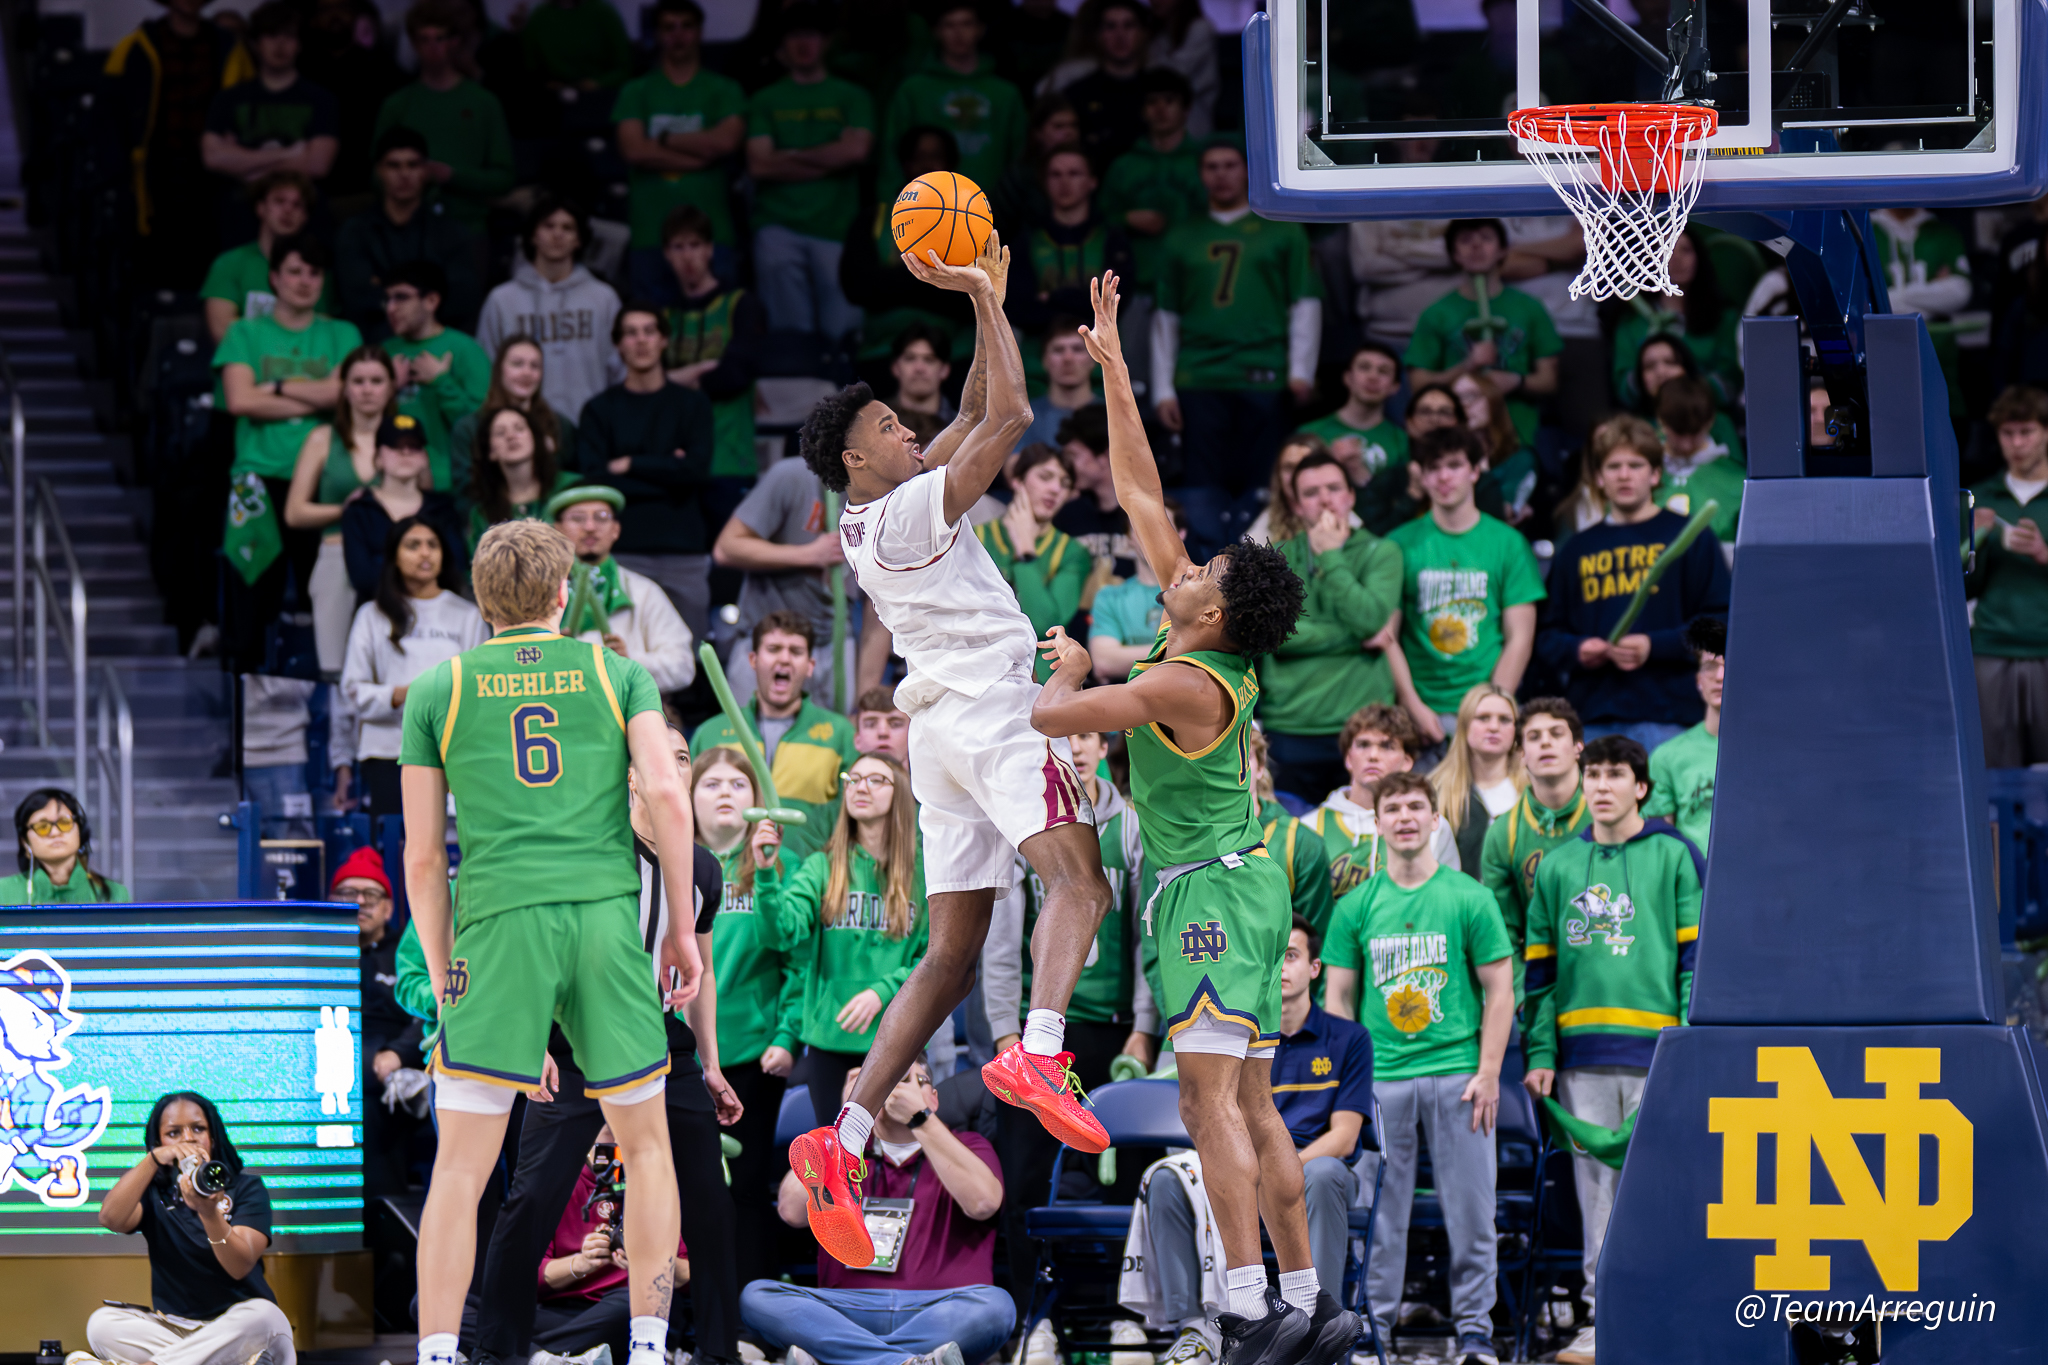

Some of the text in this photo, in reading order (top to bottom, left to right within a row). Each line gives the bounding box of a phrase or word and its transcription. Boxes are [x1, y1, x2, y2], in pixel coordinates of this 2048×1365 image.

[1208, 241, 1243, 308] 7
[514, 646, 544, 666] ND
[475, 669, 587, 698] KOEHLER
[509, 702, 564, 788] 6
[1180, 920, 1228, 963] ND
[1370, 934, 1448, 988] NOTRE DAME
[1707, 1046, 1974, 1292] ND
